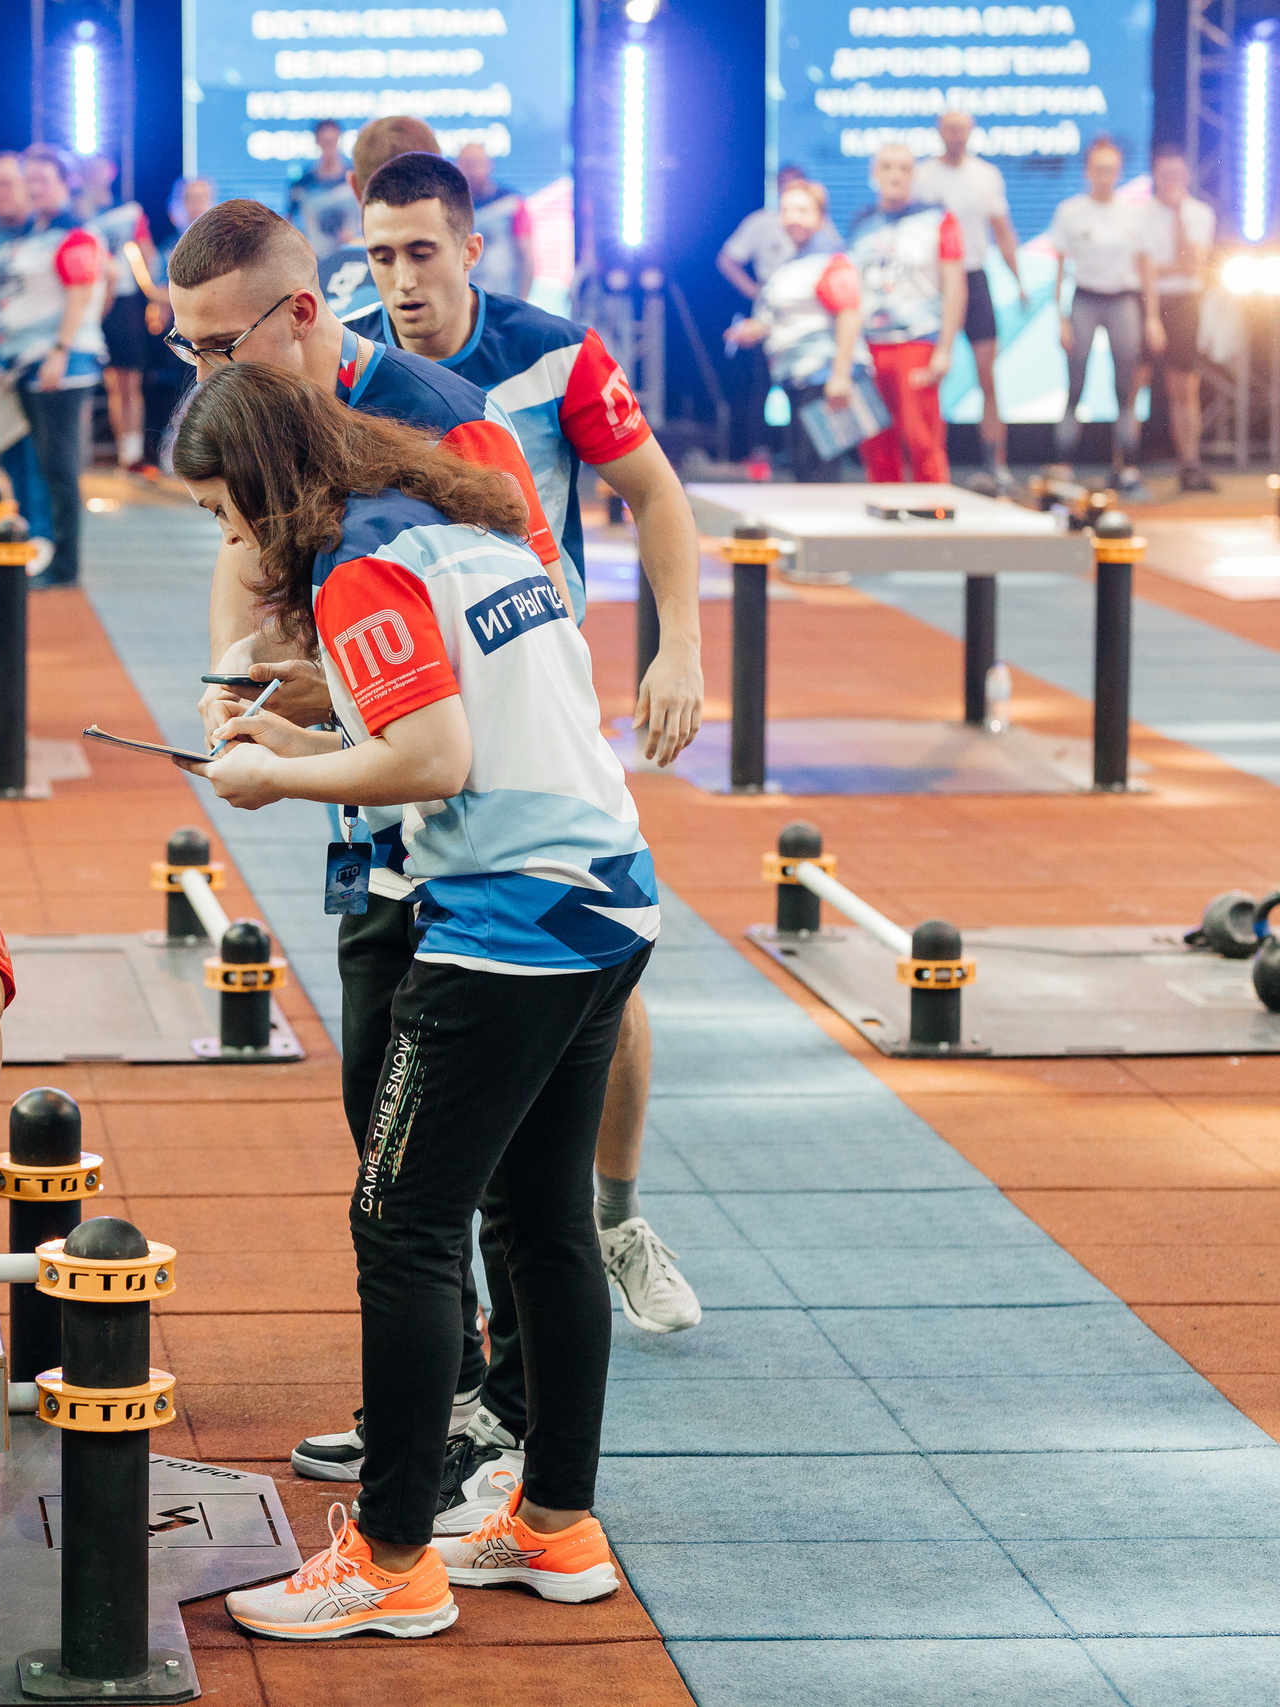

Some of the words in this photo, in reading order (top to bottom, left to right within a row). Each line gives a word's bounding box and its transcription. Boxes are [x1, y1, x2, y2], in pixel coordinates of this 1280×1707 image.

[334, 609, 414, 690] ГТО
[338, 866, 359, 880] ГТО
[360, 1151, 382, 1212] CAME
[373, 1099, 394, 1140] THE
[386, 1033, 412, 1096] SNOW
[14, 1177, 78, 1194] ГТО
[69, 1273, 146, 1291] ГТО
[69, 1402, 146, 1421] ГТО
